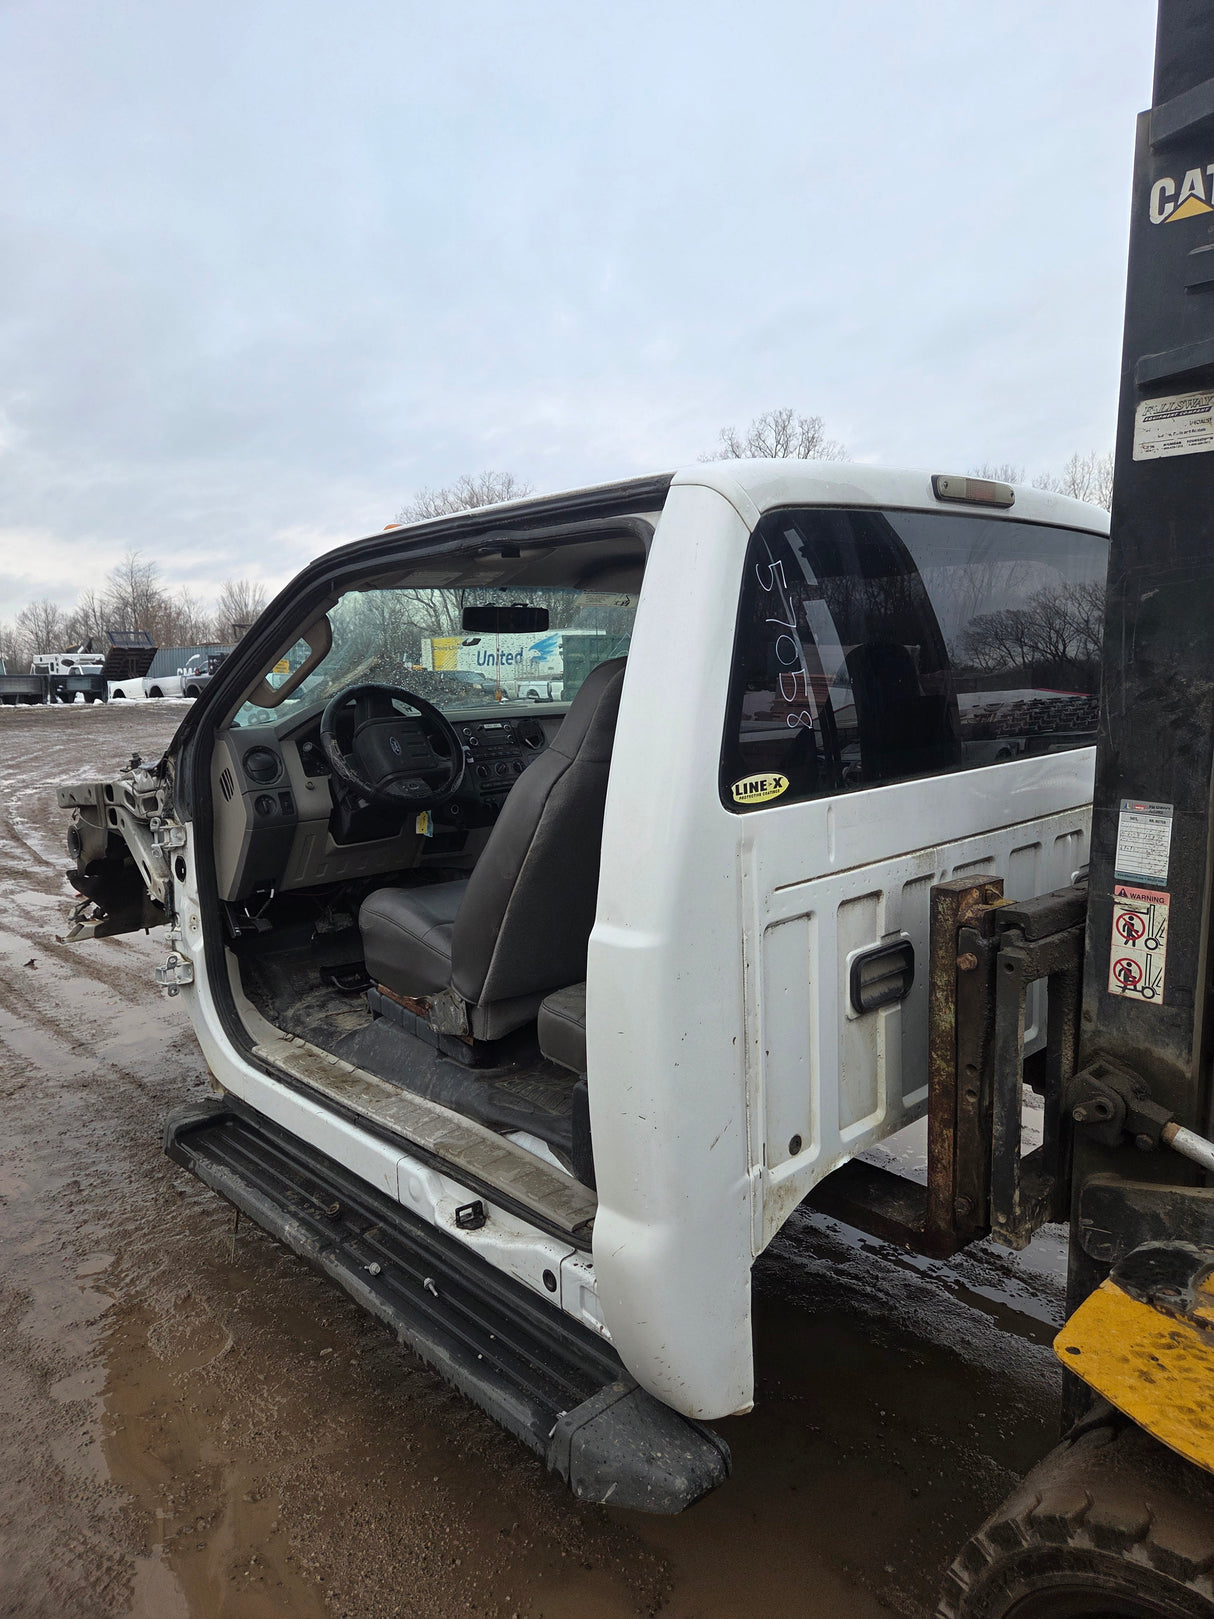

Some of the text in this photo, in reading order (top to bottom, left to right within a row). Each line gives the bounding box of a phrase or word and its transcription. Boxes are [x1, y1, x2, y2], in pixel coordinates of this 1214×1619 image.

[756, 560, 813, 729] 57058
[476, 647, 523, 667] United
[735, 776, 784, 796] LINE-X
[1129, 892, 1165, 904] WARNING
